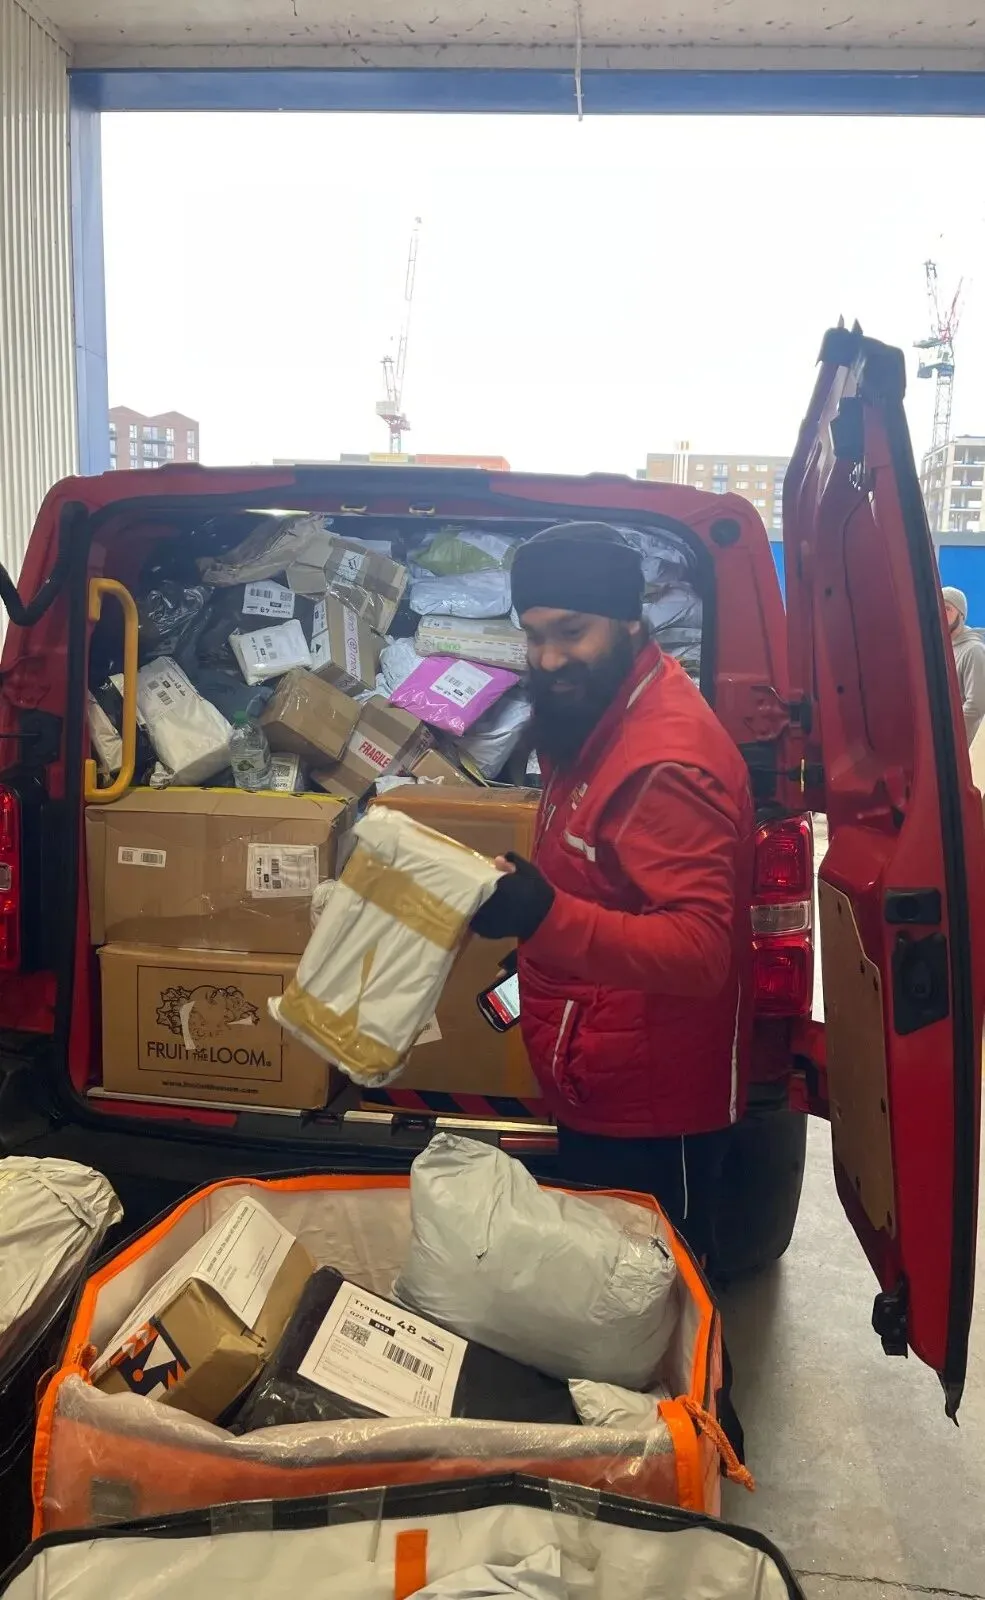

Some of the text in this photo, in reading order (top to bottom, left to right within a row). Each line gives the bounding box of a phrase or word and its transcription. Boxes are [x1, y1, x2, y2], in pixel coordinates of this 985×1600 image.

[359, 741, 391, 768] FRAGILE
[147, 1041, 189, 1061] FRUIT
[210, 1047, 266, 1067] LOOM
[354, 1299, 417, 1335] Tracked 48
